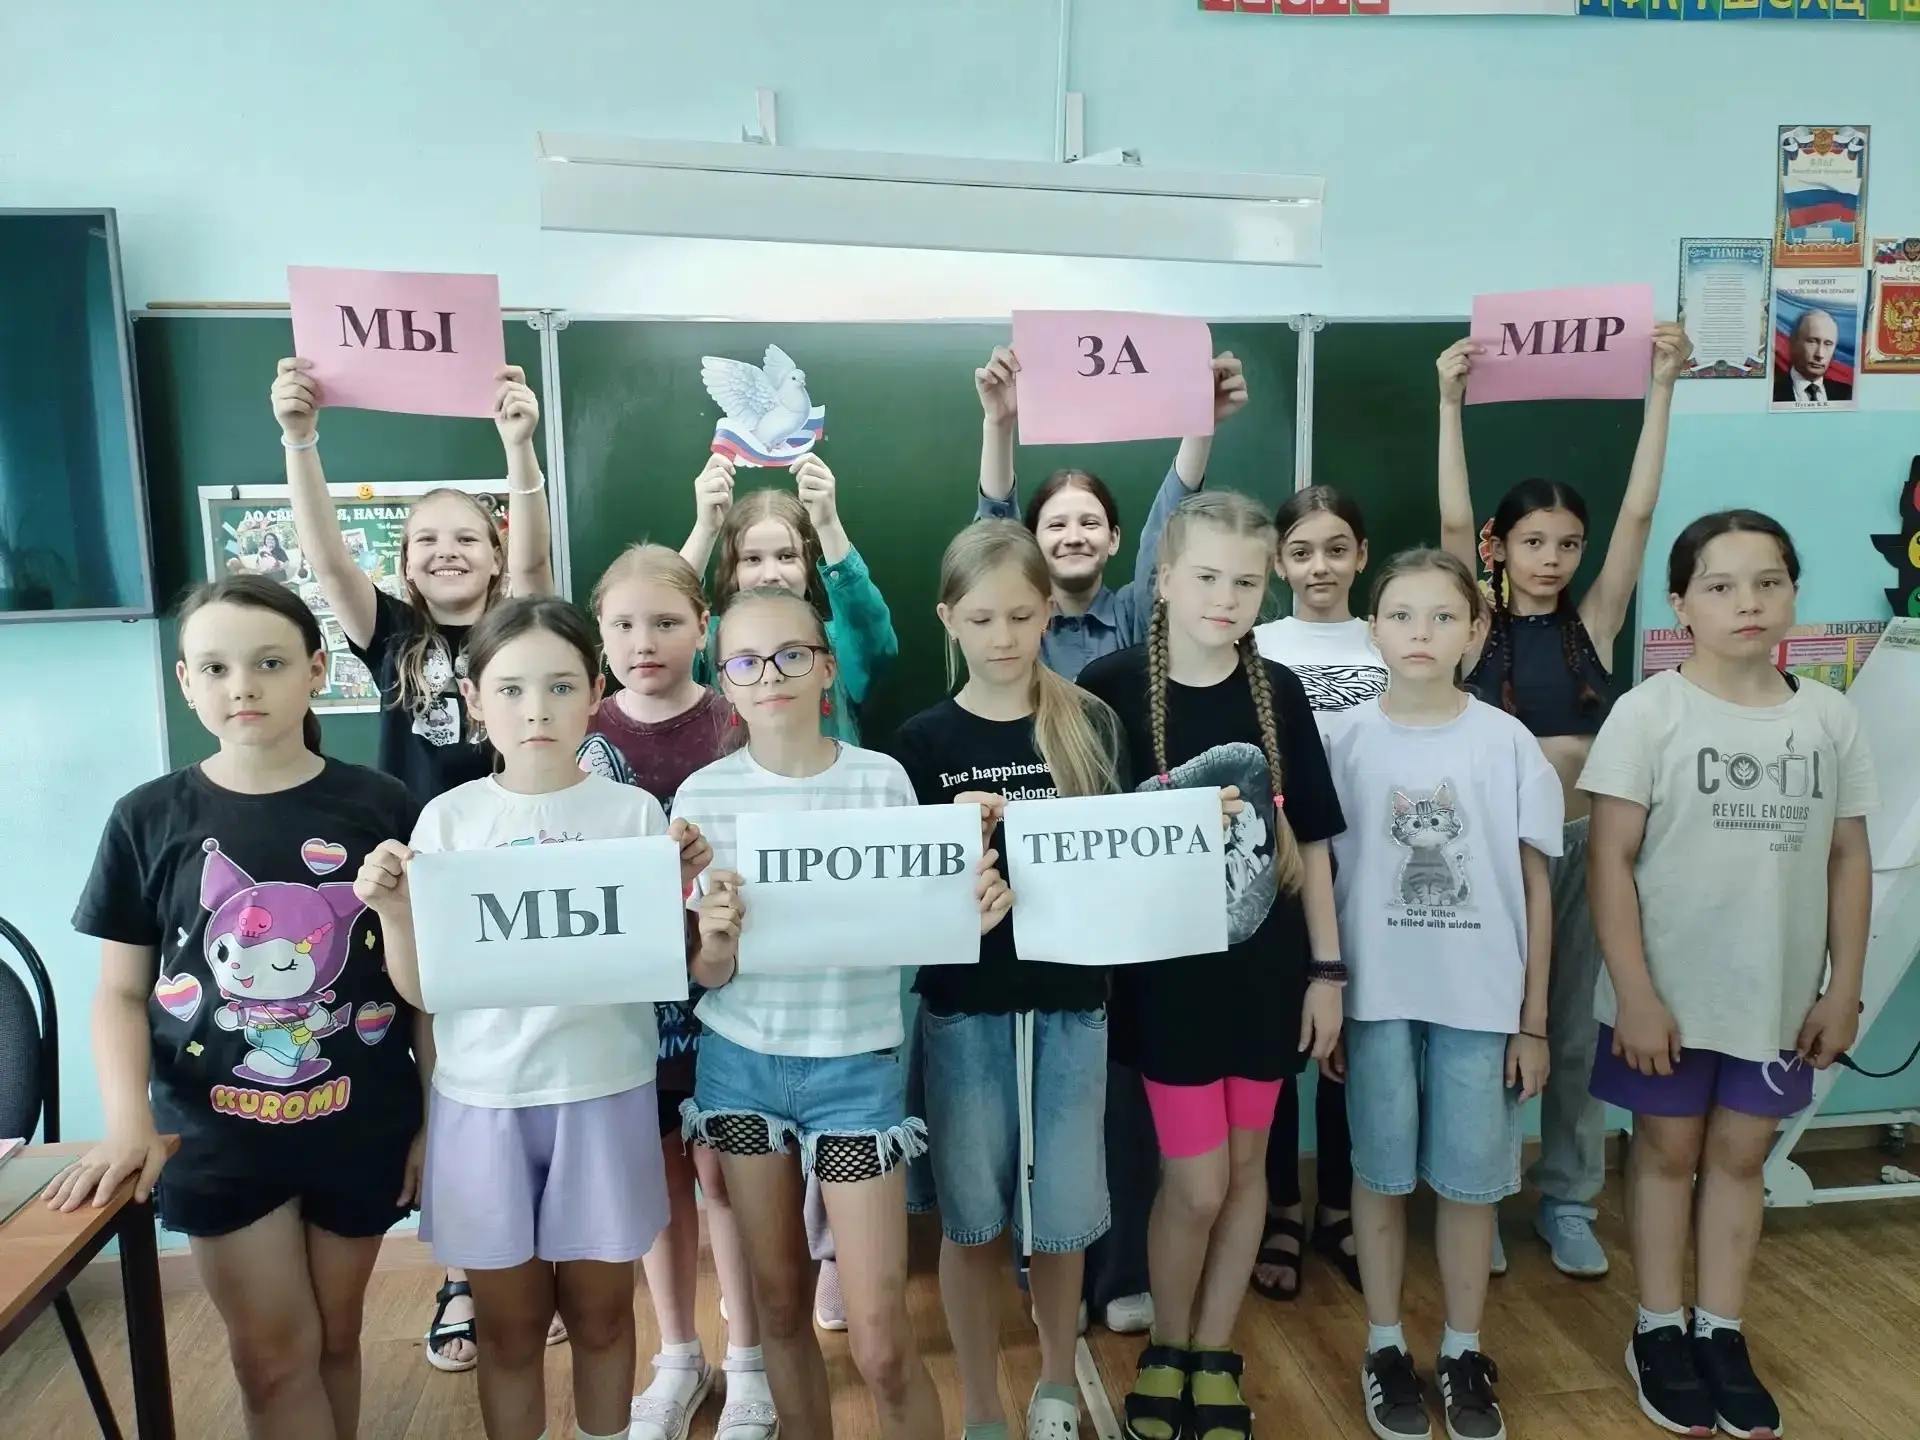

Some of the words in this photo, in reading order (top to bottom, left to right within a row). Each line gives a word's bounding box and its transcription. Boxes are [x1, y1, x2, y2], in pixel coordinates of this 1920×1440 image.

[1709, 248, 1745, 259] ГИМН
[335, 304, 458, 354] МЫ
[1497, 316, 1626, 356] МИР
[1077, 335, 1150, 377] ЗА
[1650, 629, 1690, 640] ПРАВ
[1824, 622, 1888, 636] ДВИЖЕН
[939, 771, 969, 788] True
[972, 762, 1051, 781] happiness
[1712, 803, 1756, 818] REVEIL
[1762, 804, 1777, 818] EN
[1780, 805, 1809, 820] COURS
[755, 842, 966, 884] ПРОТИВ
[1022, 824, 1211, 864] ТЕРРОРА
[470, 884, 627, 943] МЫ
[1387, 917, 1399, 927] Be
[1400, 918, 1424, 927] filled
[1427, 919, 1446, 928] with
[1448, 920, 1481, 929] wisdom
[1431, 909, 1456, 918] Kitten
[213, 1078, 348, 1121] KUROMI
